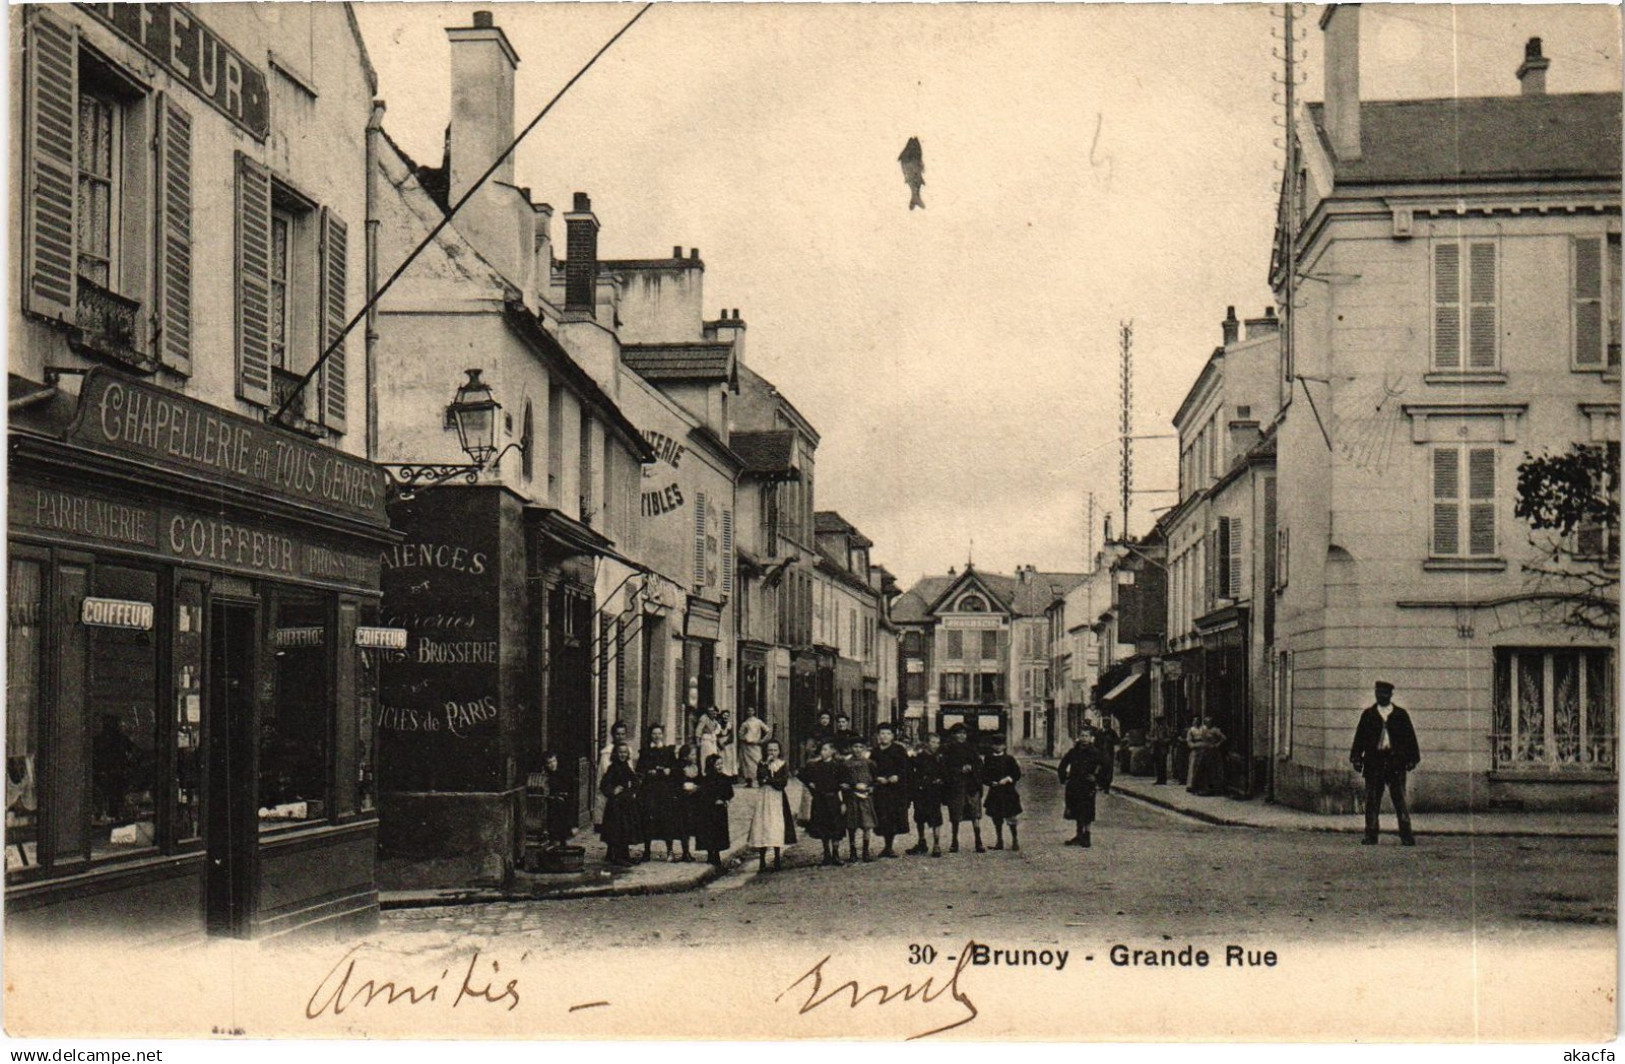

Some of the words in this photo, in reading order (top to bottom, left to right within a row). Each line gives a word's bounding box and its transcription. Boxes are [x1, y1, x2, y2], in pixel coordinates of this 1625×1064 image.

[99, 382, 252, 476] CHAPELLERIE
[254, 448, 270, 479] en
[275, 440, 318, 494] TOUS
[322, 458, 378, 511] GENRES
[168, 514, 293, 572] COIFFEUR
[83, 601, 152, 627] COIFFEUR
[356, 628, 406, 647] COIFFEUR
[418, 636, 498, 664] BROSSERIE
[423, 711, 441, 731] de
[443, 695, 498, 739] PARIS
